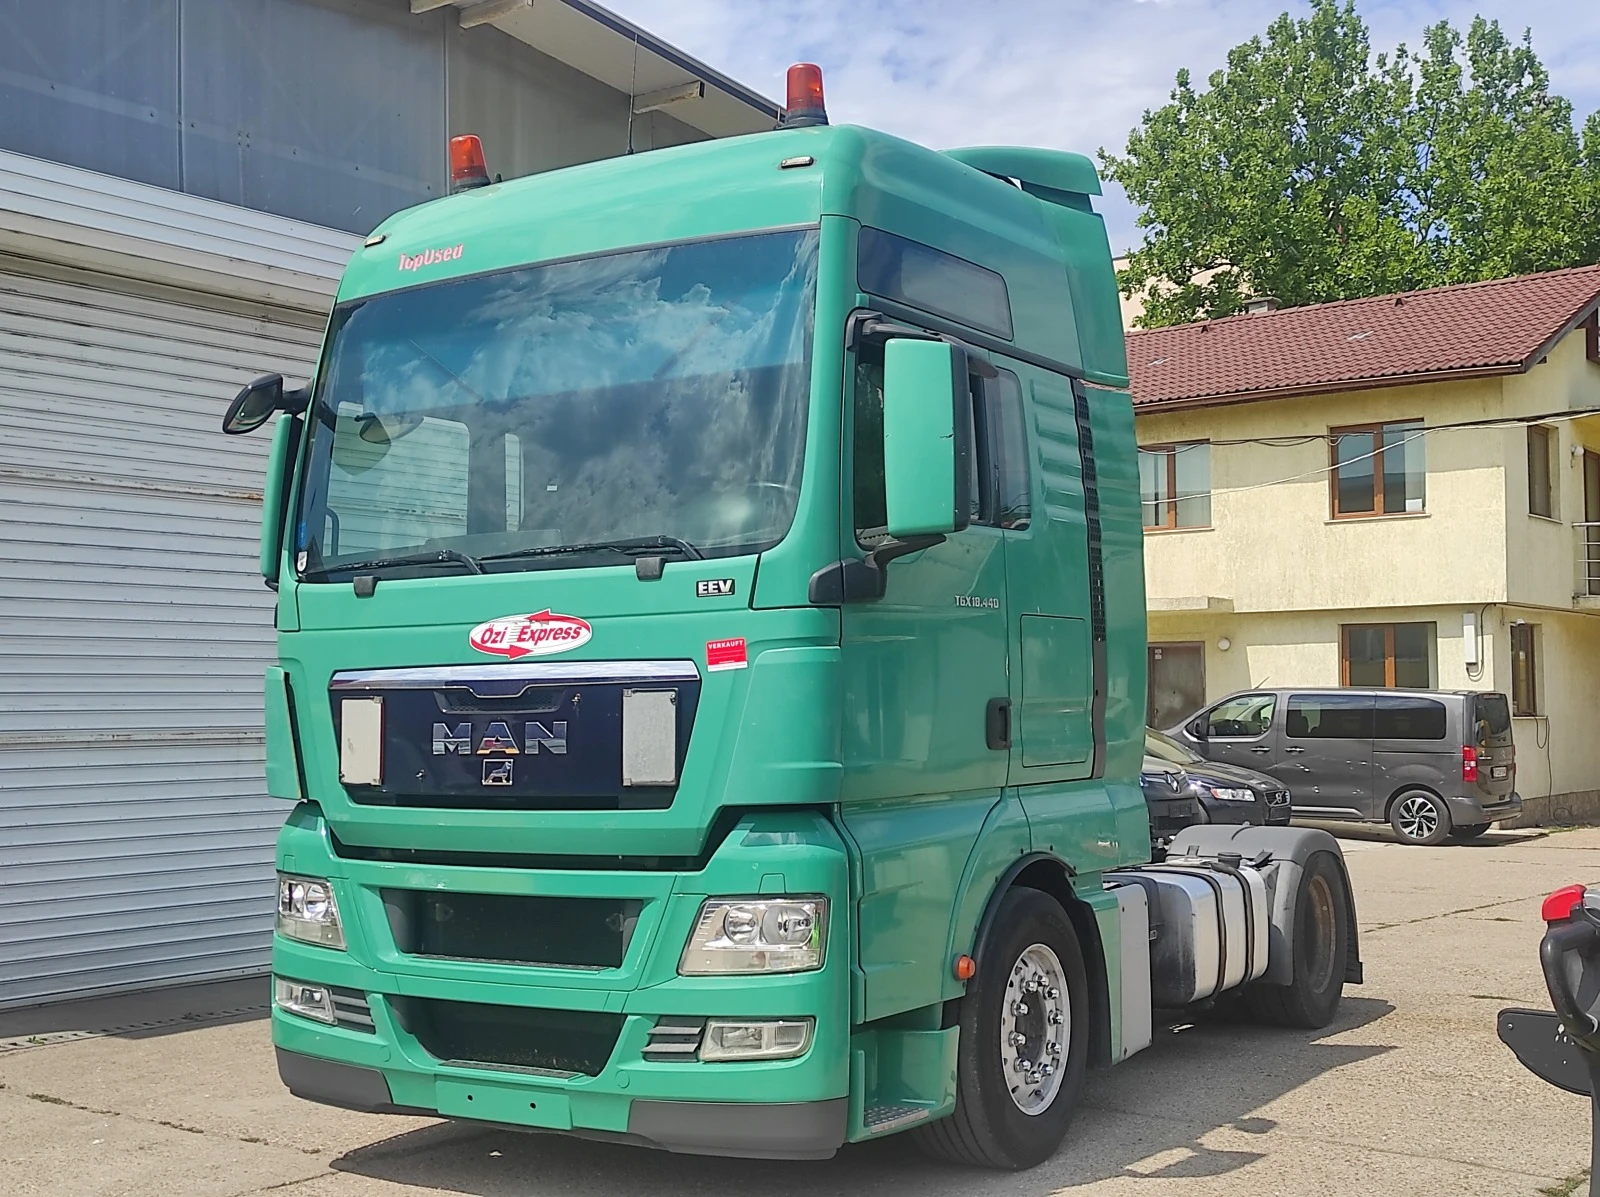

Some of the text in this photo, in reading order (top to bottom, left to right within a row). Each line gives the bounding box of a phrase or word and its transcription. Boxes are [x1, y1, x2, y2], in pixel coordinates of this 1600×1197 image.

[698, 579, 733, 594] EEV
[480, 624, 582, 646] Özi Express
[708, 640, 744, 650] VERKAUFT
[432, 720, 568, 755] MAN
